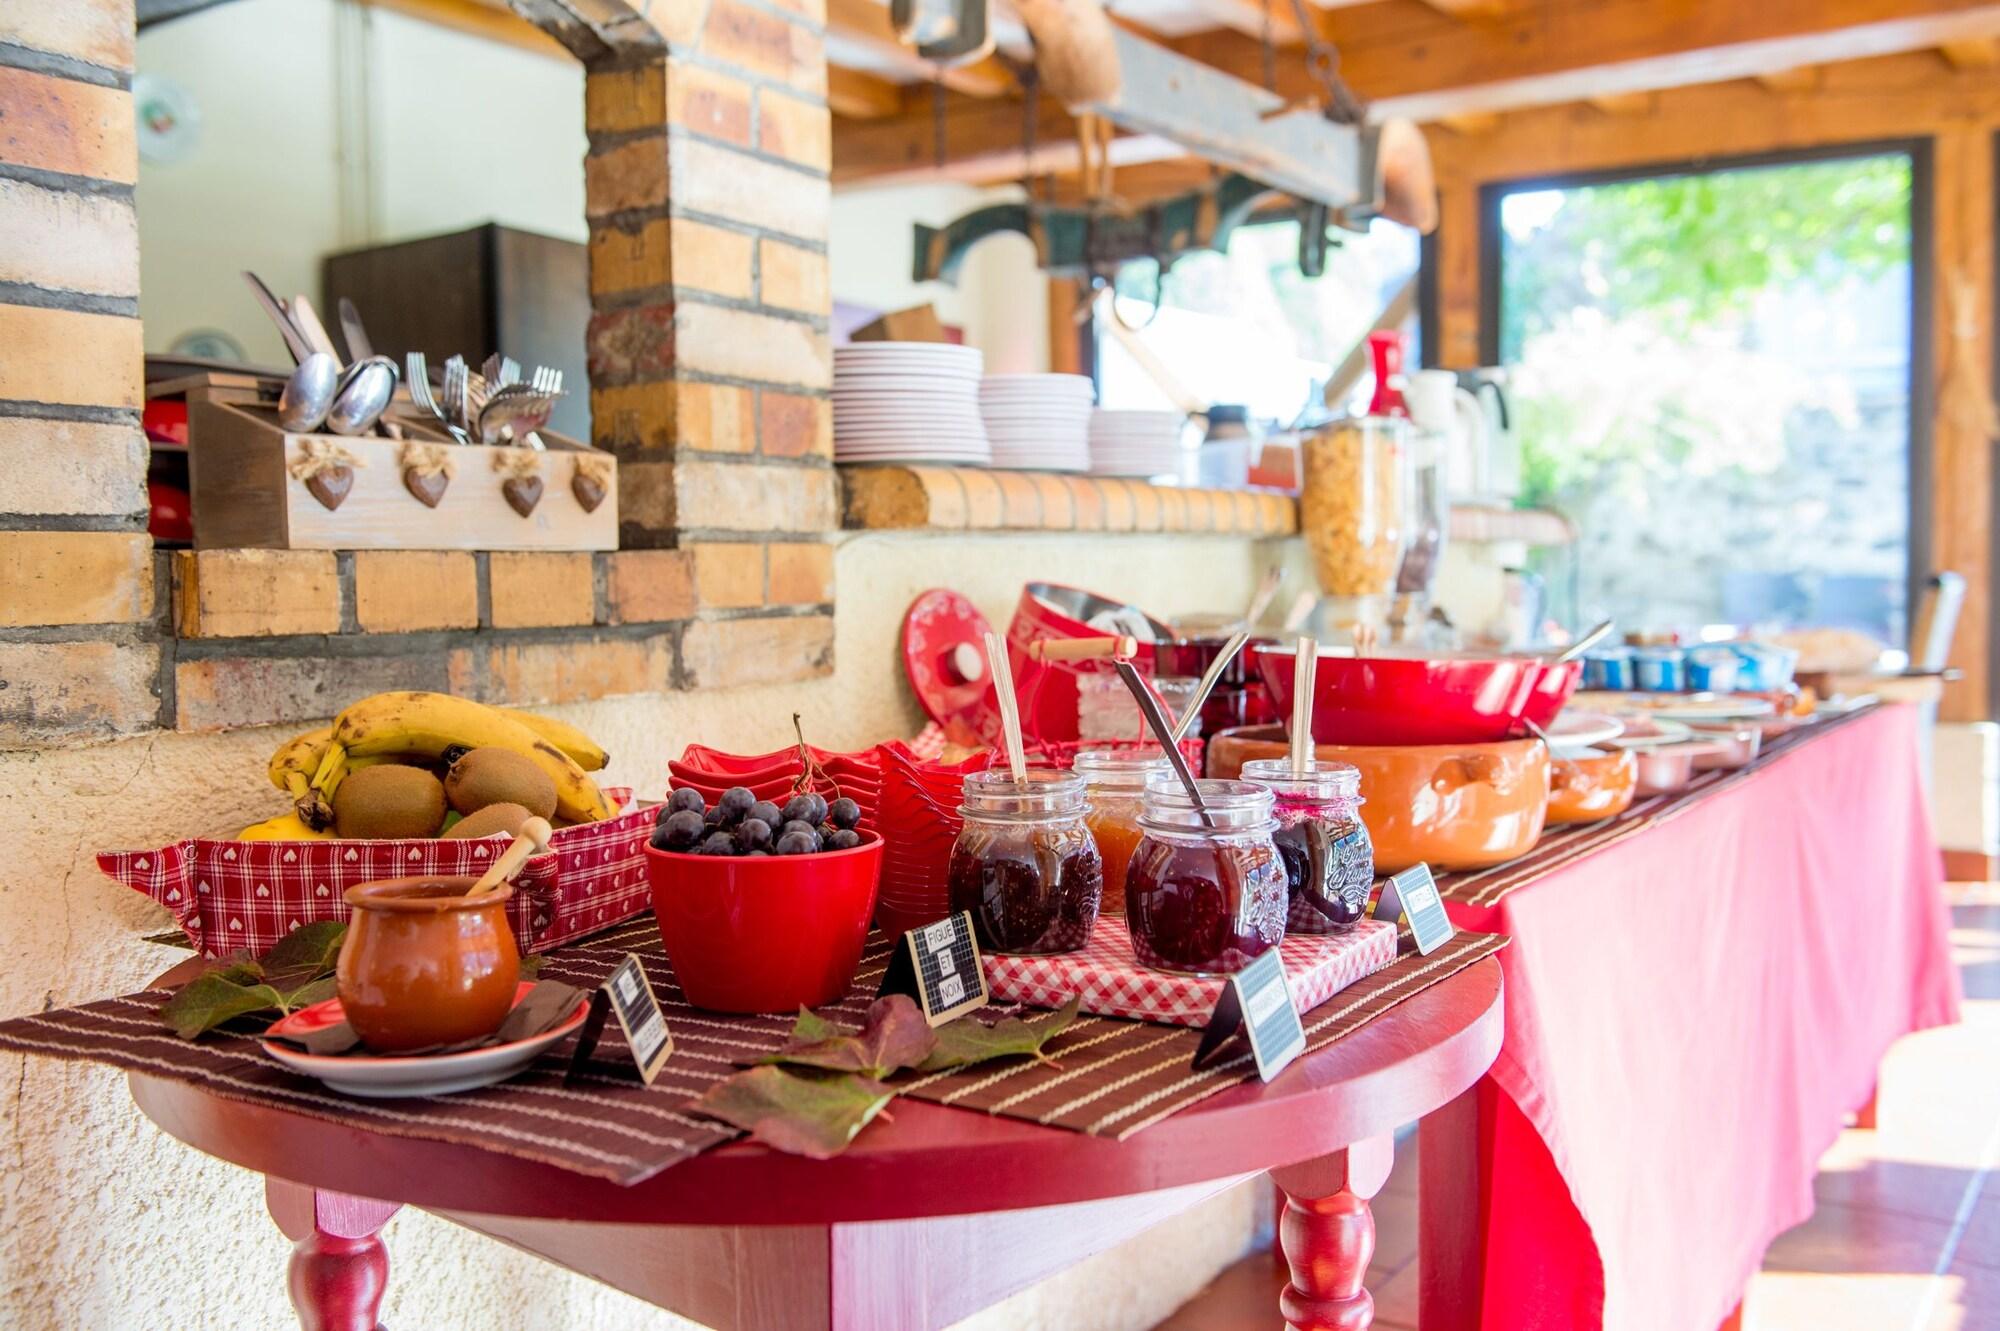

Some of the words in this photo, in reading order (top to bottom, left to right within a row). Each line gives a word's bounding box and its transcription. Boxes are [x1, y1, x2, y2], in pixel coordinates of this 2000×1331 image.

[928, 924, 953, 946] FIGUE
[940, 953, 951, 969] ET
[941, 980, 962, 999] NOIX
